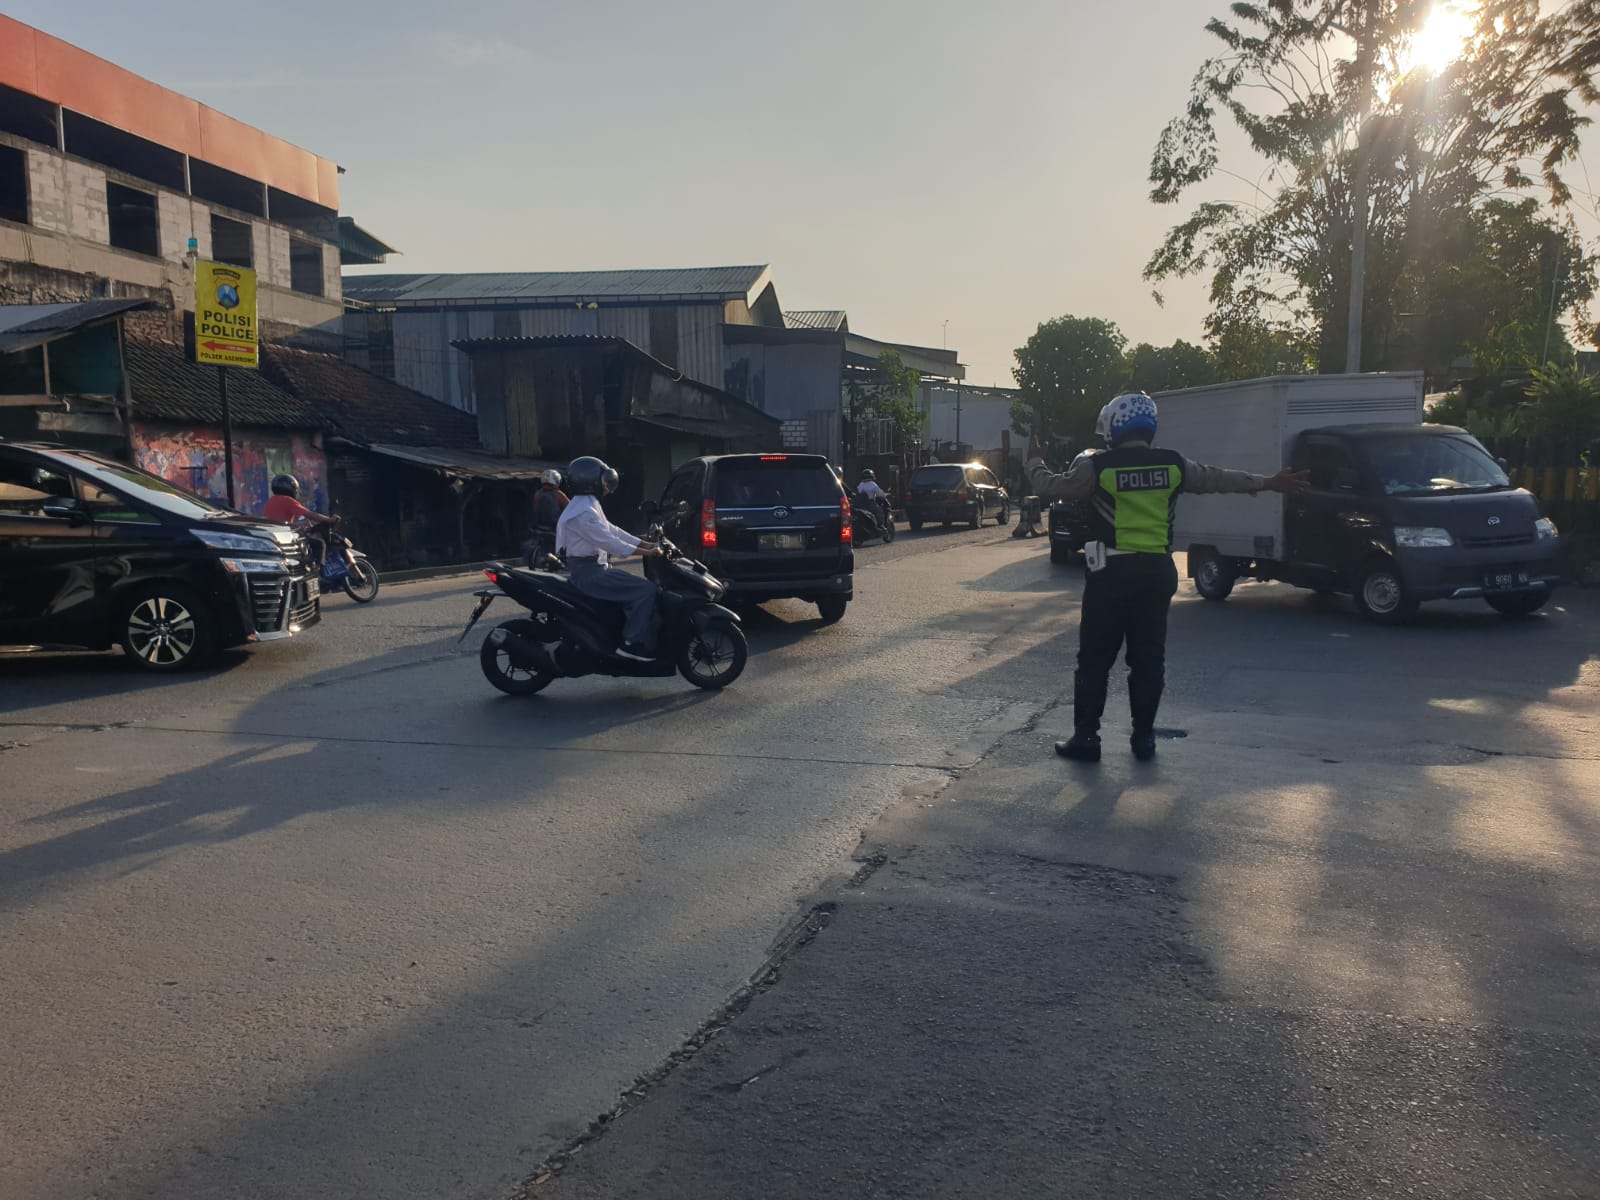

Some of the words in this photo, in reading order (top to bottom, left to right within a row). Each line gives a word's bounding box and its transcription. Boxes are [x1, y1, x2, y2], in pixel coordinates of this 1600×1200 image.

[203, 310, 251, 327] POLISI
[201, 323, 254, 340] POLICE
[1119, 470, 1168, 489] POLISI
